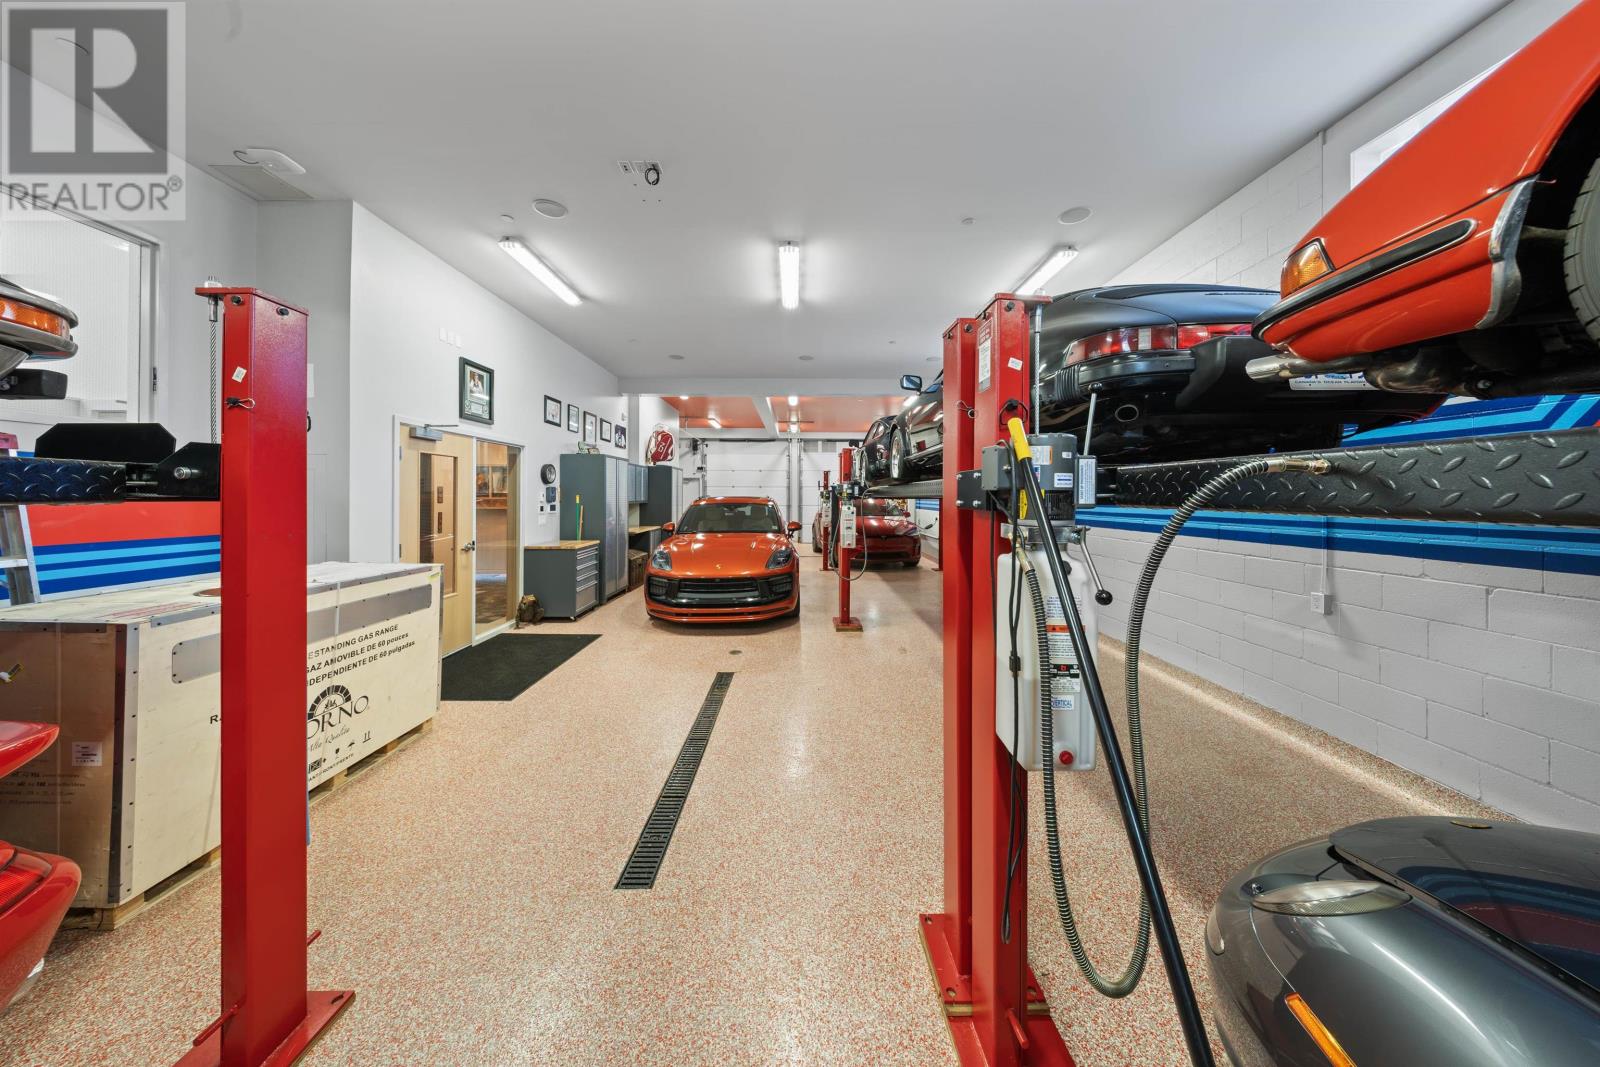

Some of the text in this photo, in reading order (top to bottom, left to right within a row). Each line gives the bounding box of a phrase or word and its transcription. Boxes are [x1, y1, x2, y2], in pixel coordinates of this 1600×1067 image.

[307, 624, 399, 660] ESTANDING GAS RANGE
[323, 647, 365, 668] AMOVIBLE
[366, 644, 376, 652] DE
[377, 640, 386, 648] 60
[386, 632, 409, 646] pouces
[306, 640, 416, 686] DEPENDIENTE DE 60 pulgadas
[307, 695, 369, 740] ORNO
